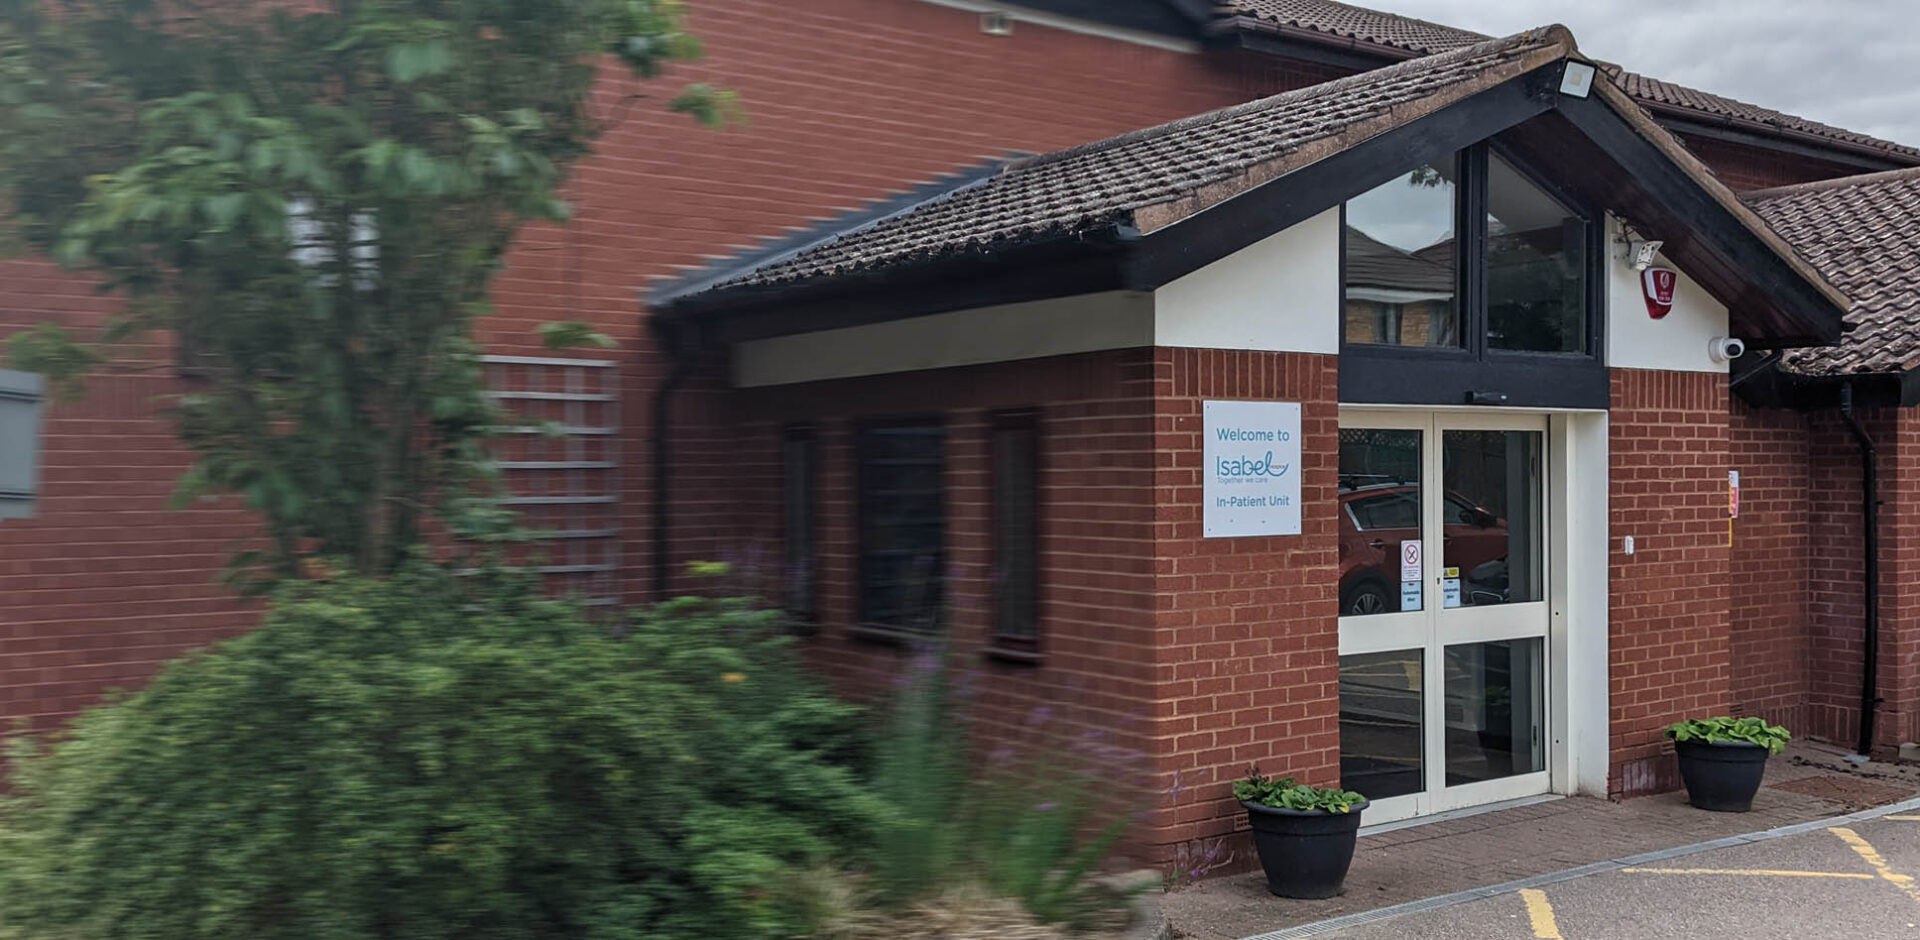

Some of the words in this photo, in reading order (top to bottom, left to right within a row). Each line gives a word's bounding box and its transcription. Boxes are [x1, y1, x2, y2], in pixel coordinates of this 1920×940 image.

[1217, 428, 1274, 441] Welcome
[1278, 429, 1290, 441] to
[1217, 450, 1289, 477] Isabel
[1216, 496, 1266, 508] In-Patient
[1269, 495, 1290, 506] Unit
